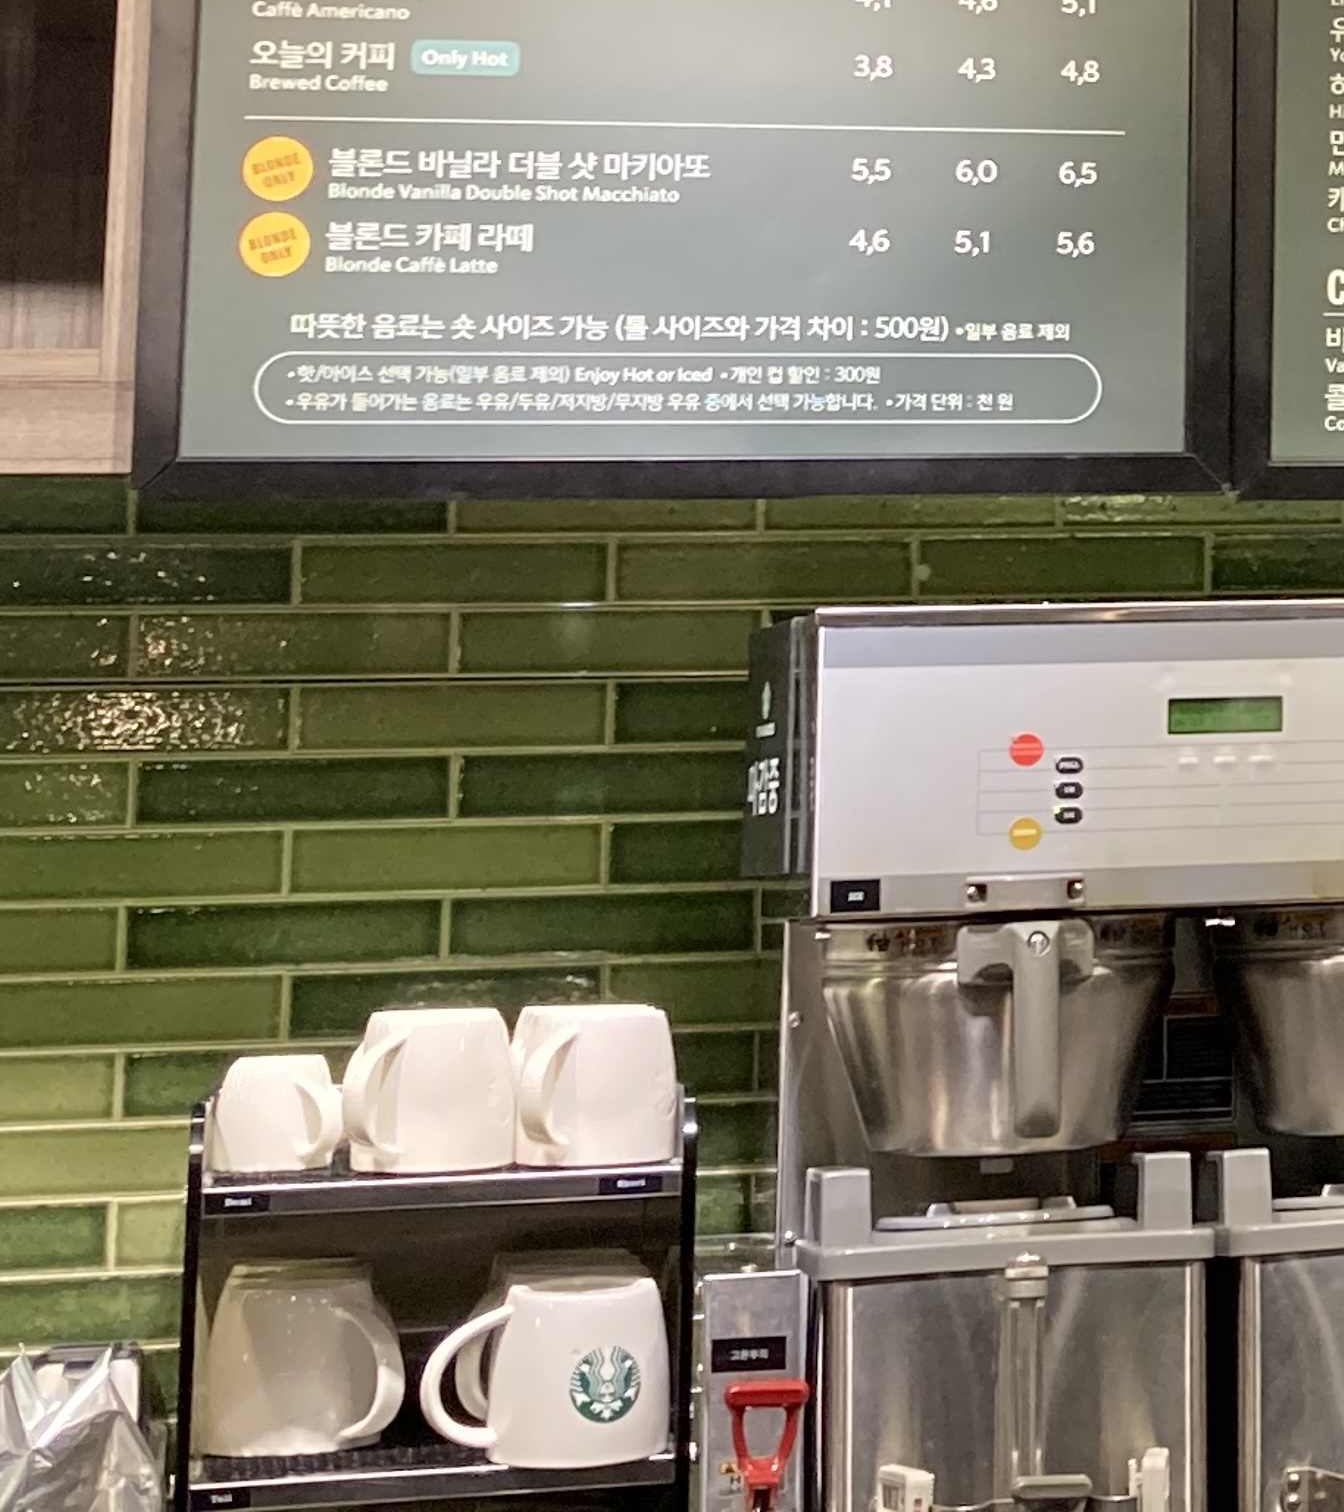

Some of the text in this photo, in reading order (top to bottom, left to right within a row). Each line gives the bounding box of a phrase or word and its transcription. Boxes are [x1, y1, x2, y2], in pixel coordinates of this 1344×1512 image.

[251, 0, 411, 20] Caffè Americano
[248, 39, 510, 71] 오늘의 커피 Only Hot
